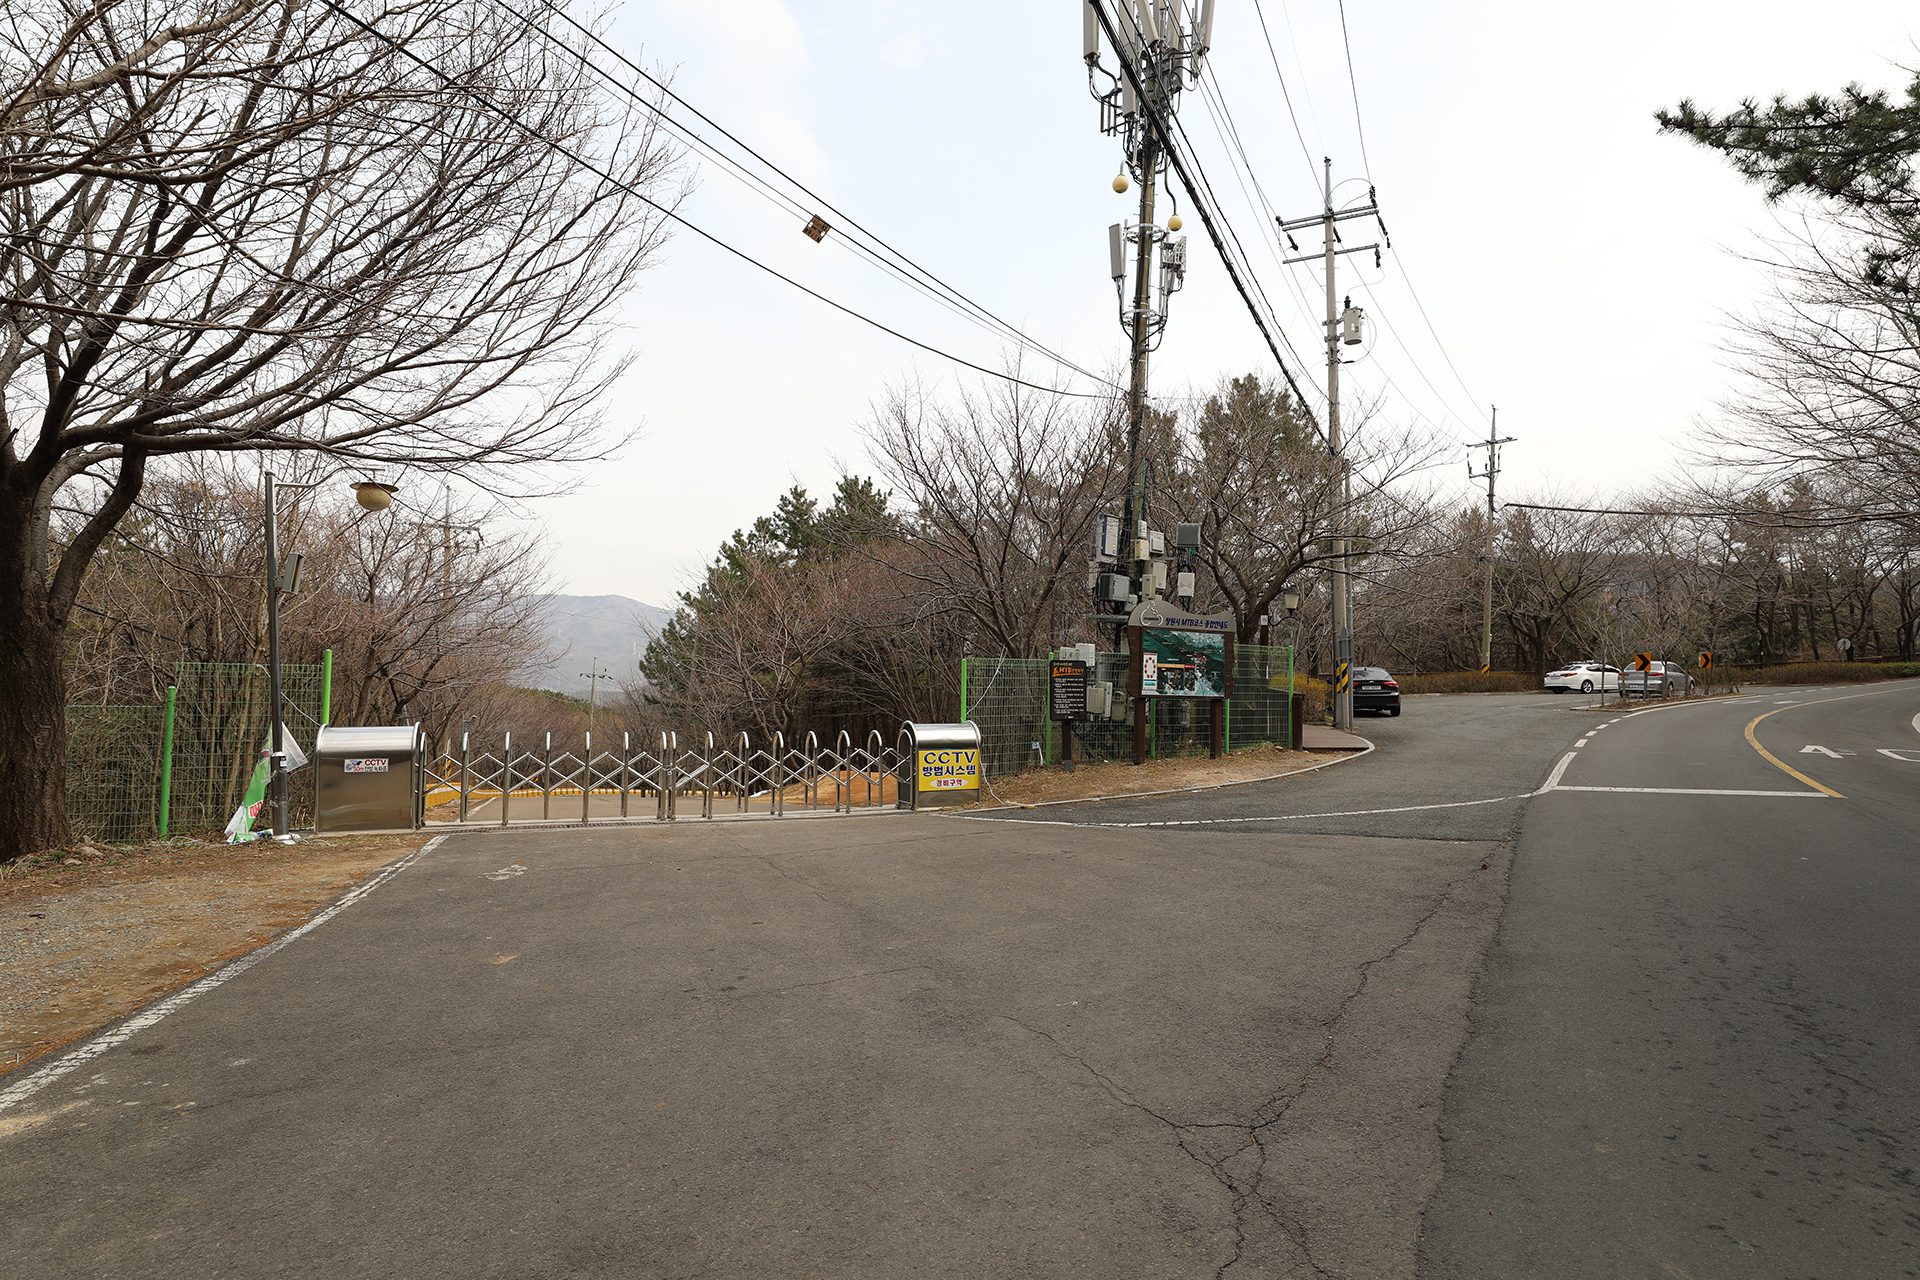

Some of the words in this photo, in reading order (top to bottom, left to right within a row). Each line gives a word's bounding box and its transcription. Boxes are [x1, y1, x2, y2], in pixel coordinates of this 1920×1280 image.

[923, 751, 976, 765] CCTV
[922, 765, 976, 777] 방범시스템
[936, 779, 963, 788] 경비구역
